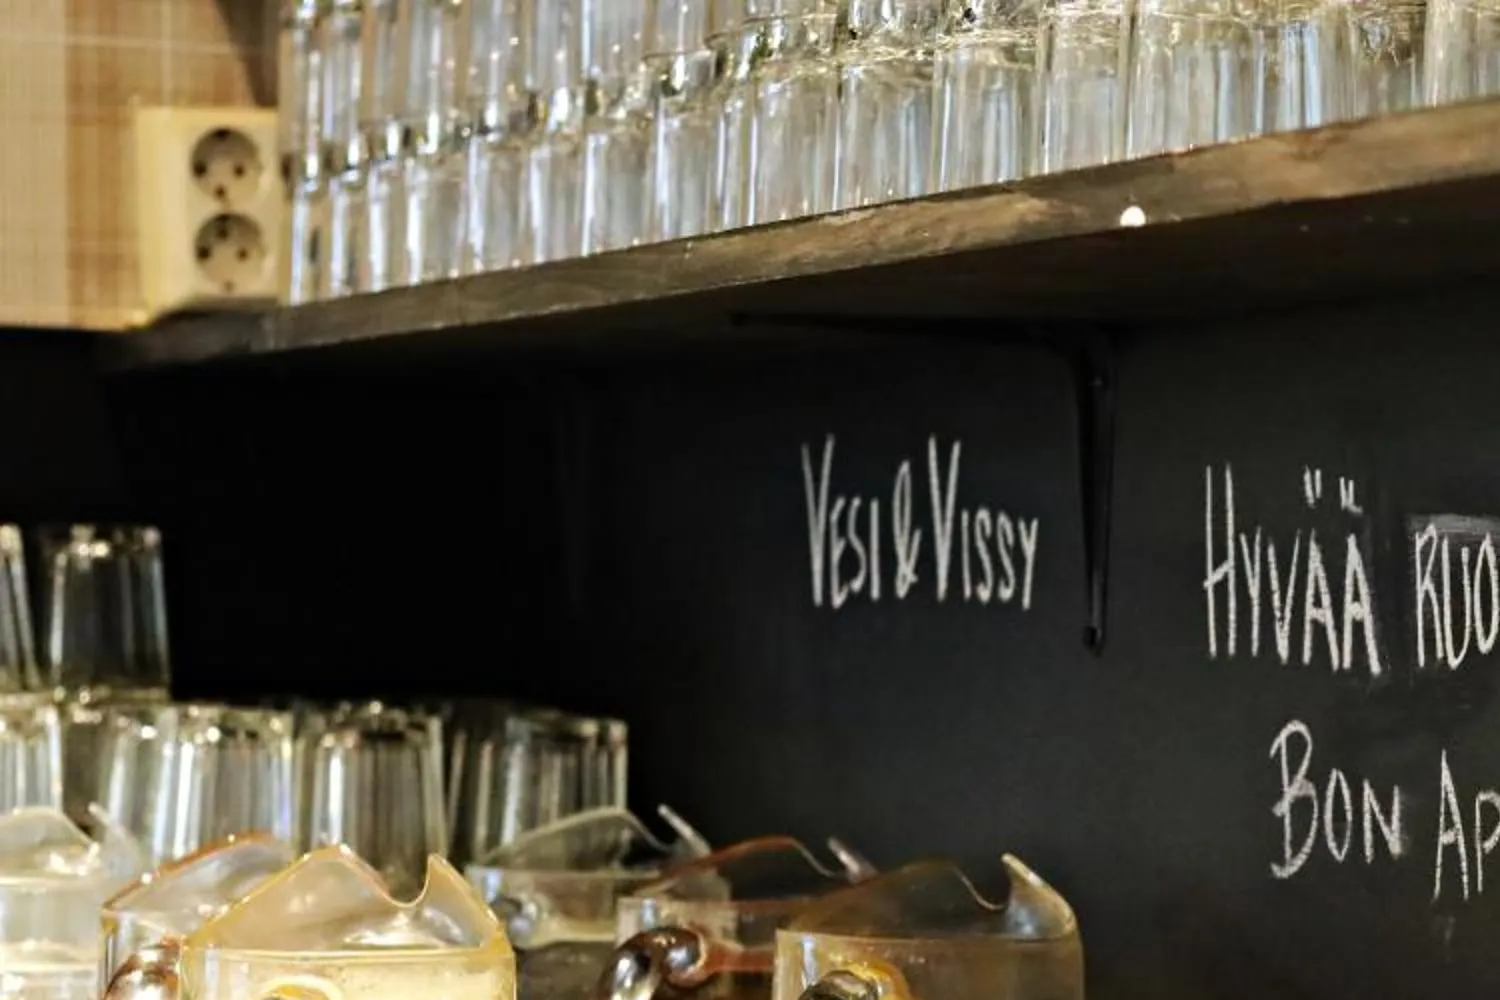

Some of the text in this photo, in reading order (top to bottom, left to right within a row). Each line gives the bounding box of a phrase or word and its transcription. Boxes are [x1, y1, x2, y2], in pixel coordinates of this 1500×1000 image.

[928, 433, 1039, 611] VISSY
[1202, 463, 1382, 676] HYVÄÄ
[1268, 719, 1404, 880] BON
